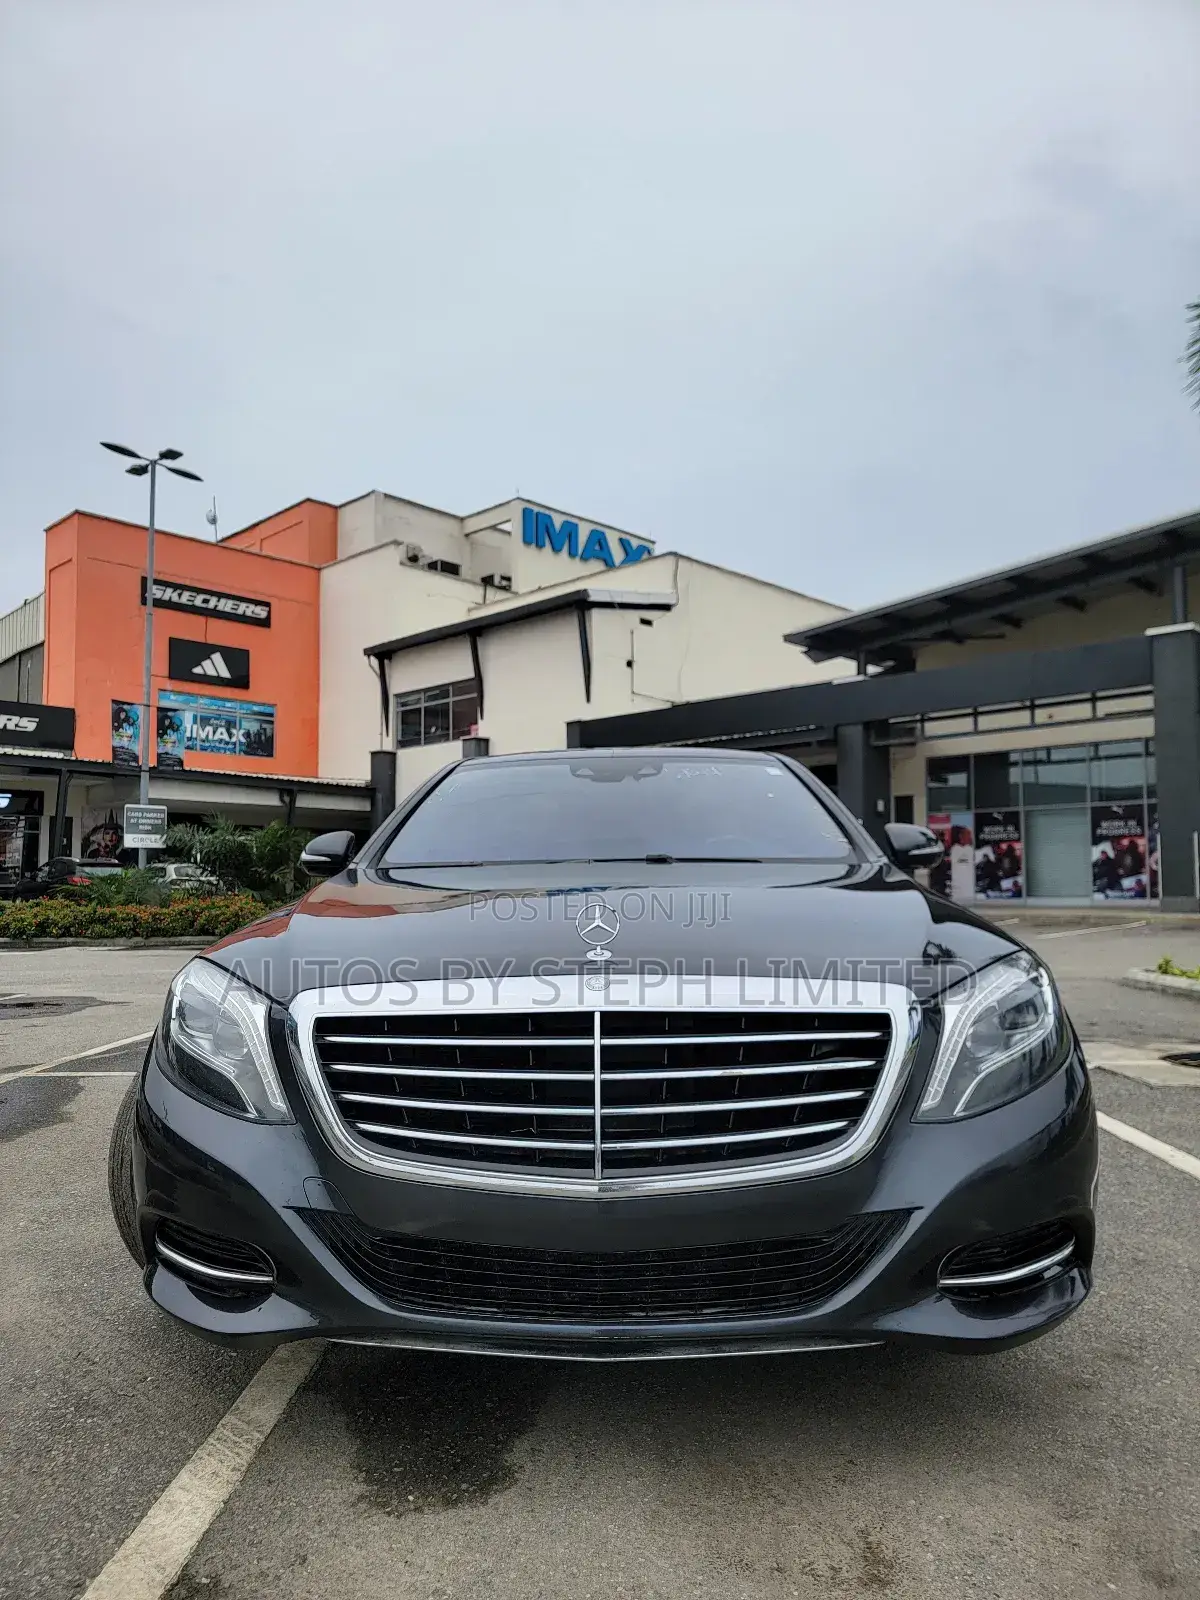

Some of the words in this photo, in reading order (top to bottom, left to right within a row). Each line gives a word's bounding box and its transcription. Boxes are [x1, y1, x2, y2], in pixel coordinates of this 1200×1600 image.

[522, 507, 651, 568] IMAX
[146, 583, 270, 619] SKECHERS
[185, 724, 247, 743] IMAX
